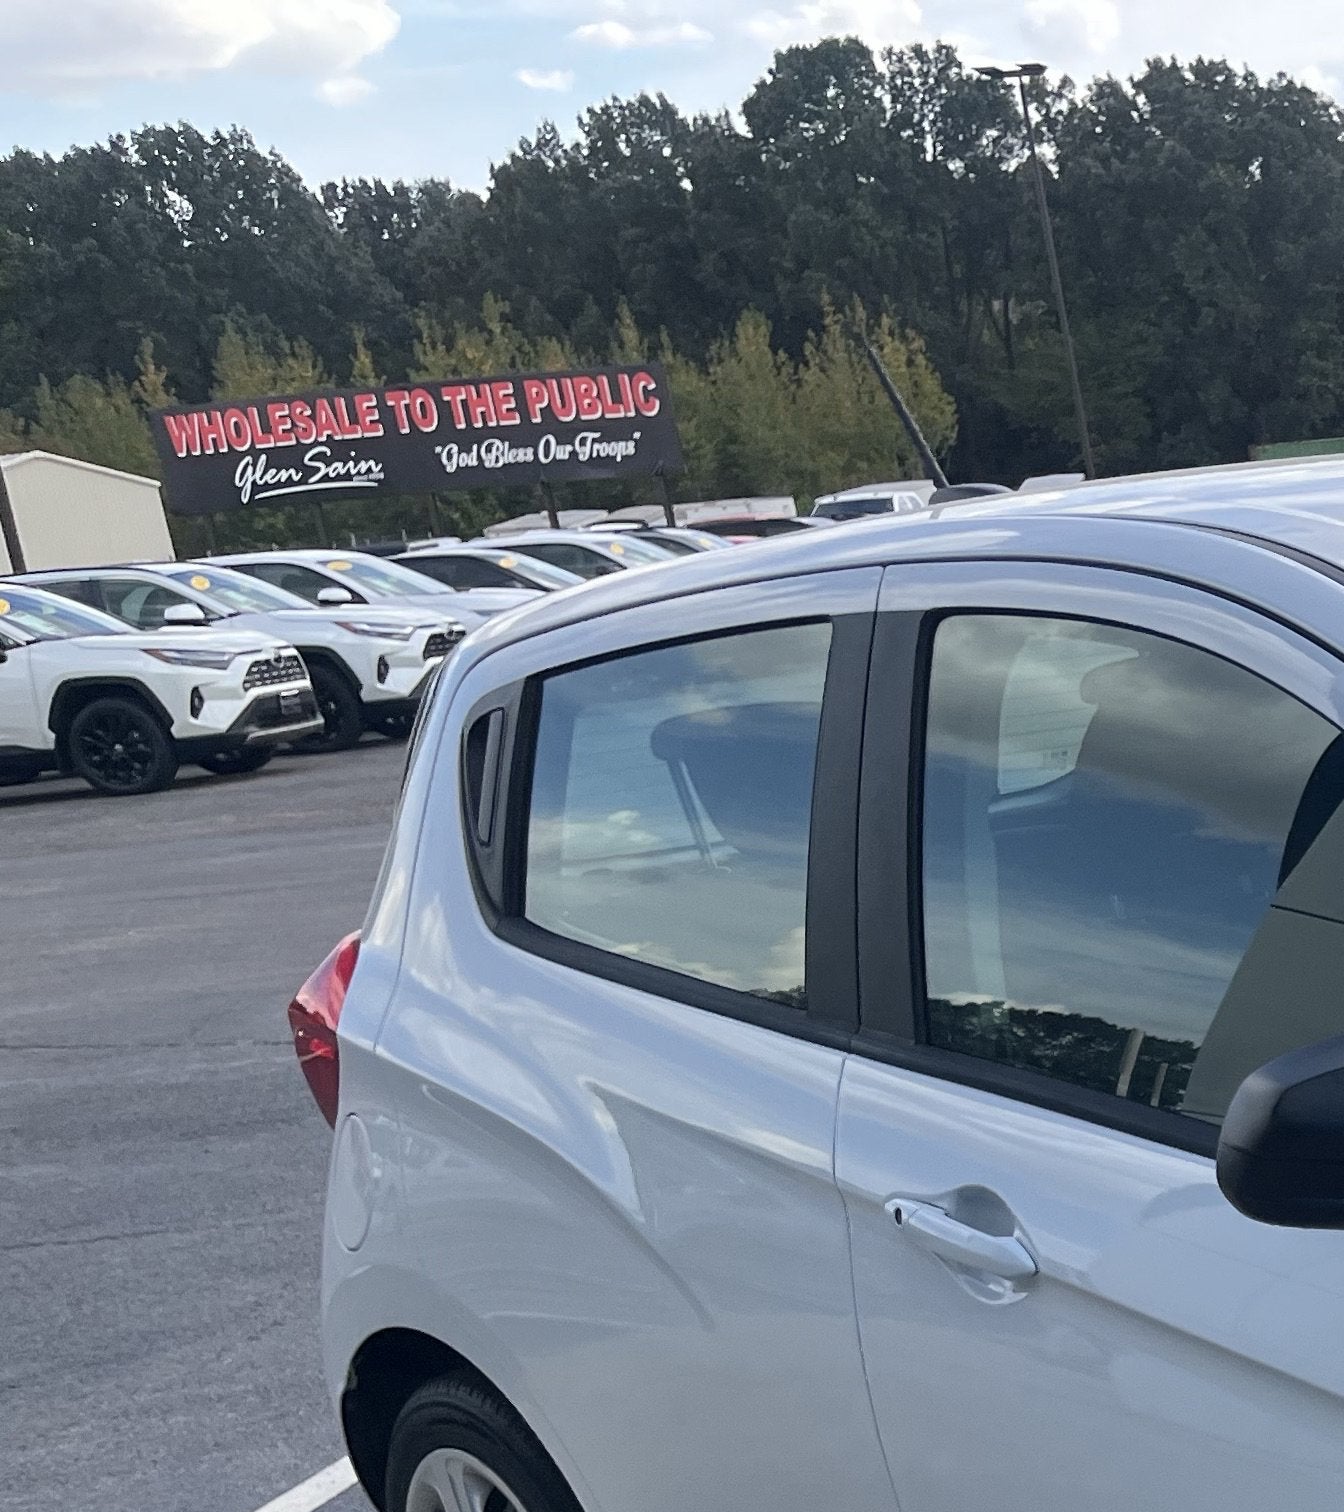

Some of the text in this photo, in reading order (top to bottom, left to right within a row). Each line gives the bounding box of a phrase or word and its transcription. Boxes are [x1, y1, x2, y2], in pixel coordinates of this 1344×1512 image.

[163, 371, 661, 458] WHOLESALE TO THE PUBLIC
[235, 446, 383, 504] Glen Sain
[480, 438, 534, 468] Bless
[538, 434, 573, 464] Our
